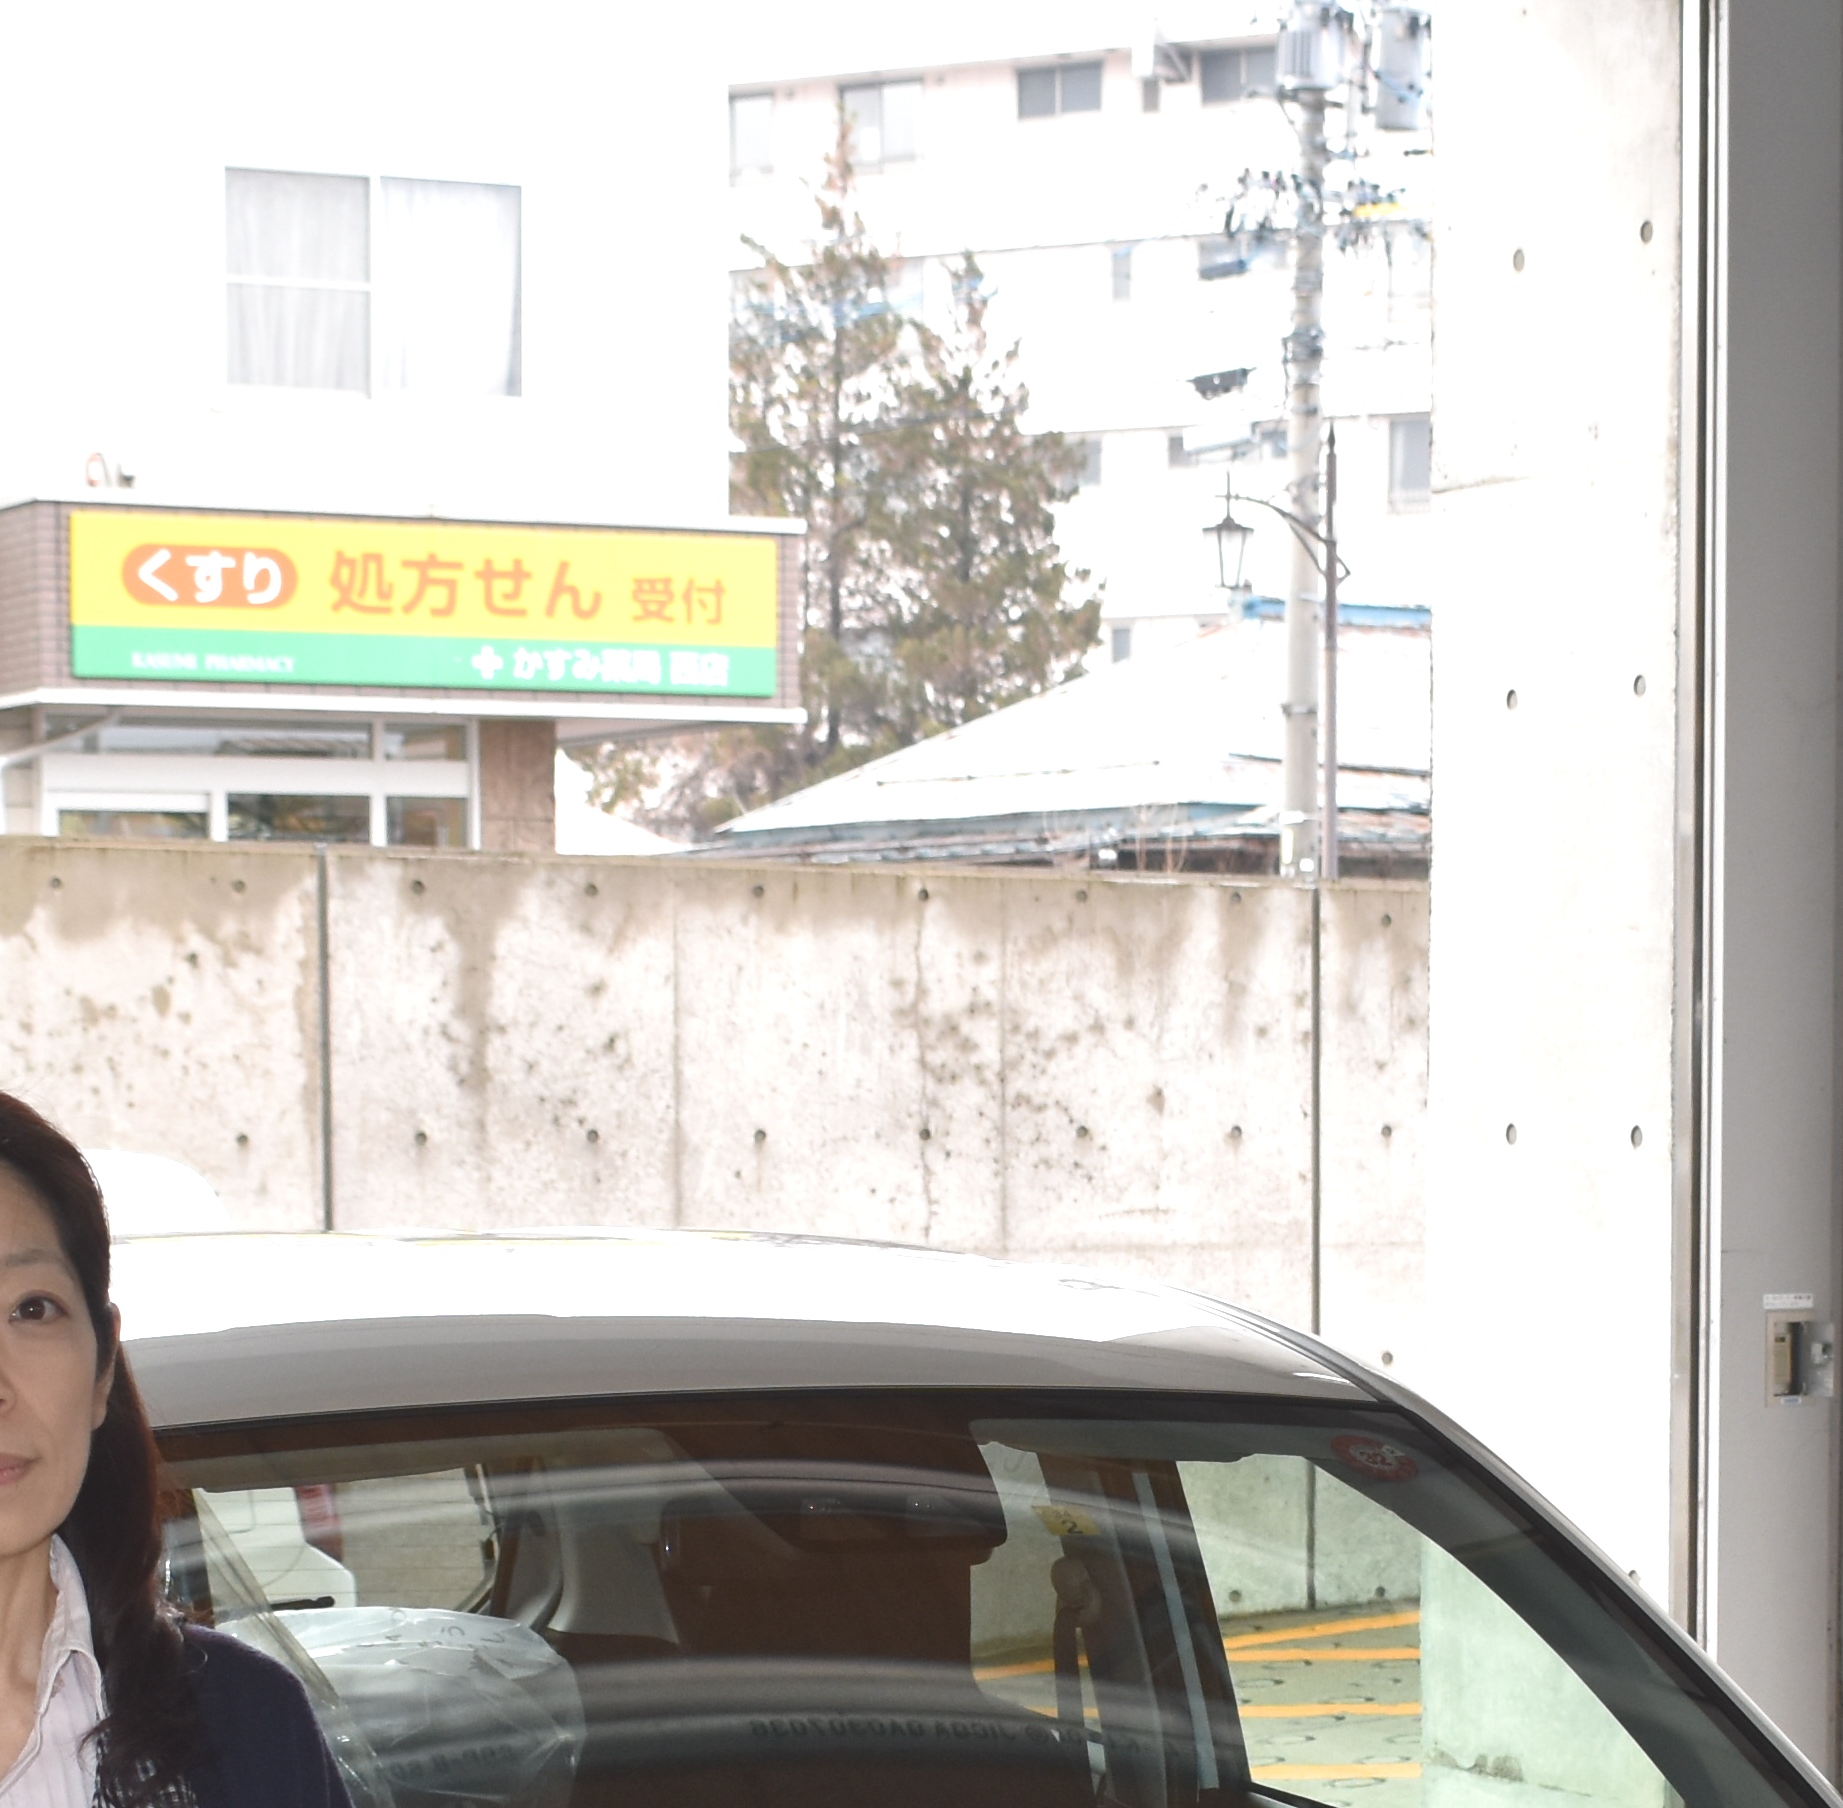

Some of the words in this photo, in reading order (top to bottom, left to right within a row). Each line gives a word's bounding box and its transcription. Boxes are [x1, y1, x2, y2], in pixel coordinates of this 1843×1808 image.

[136, 547, 286, 605] くすり
[330, 550, 603, 621] 処方せん
[630, 576, 727, 626] 受付
[204, 654, 295, 674] PHARMACY
